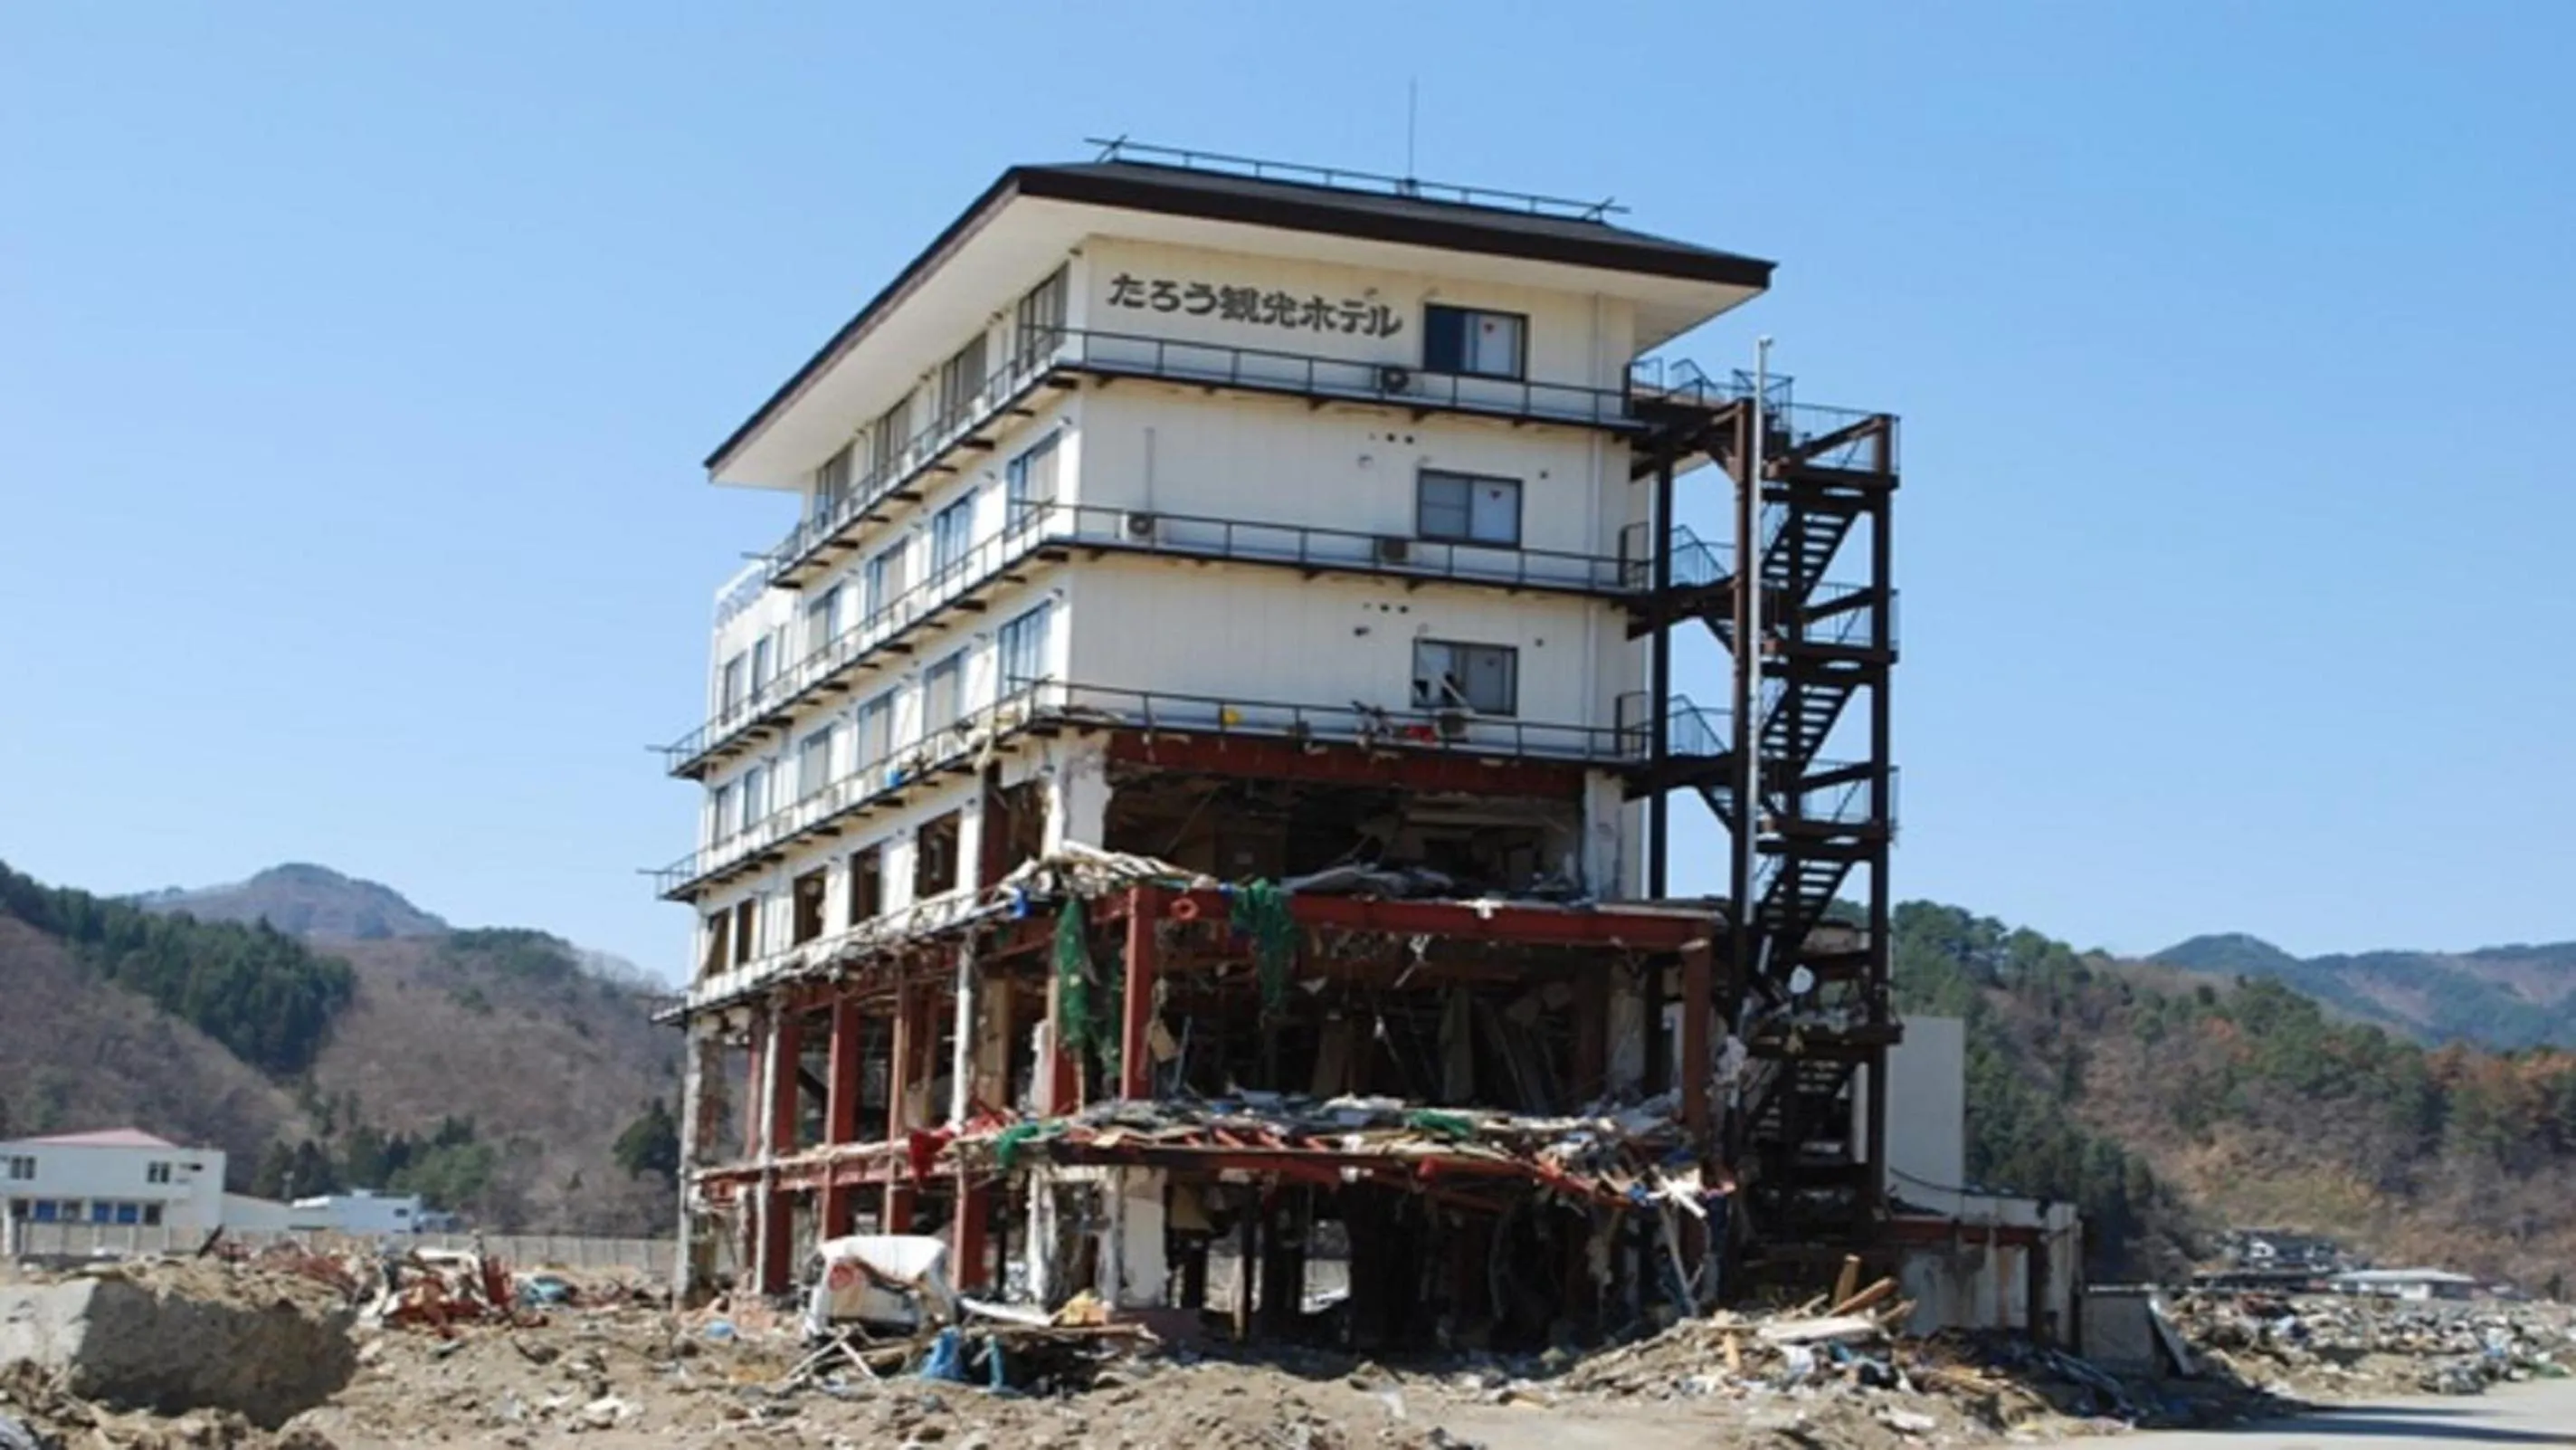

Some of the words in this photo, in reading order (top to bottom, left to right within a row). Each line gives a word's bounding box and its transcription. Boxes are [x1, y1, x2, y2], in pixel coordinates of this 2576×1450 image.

[1107, 272, 1402, 339] たろう観光ホテル
